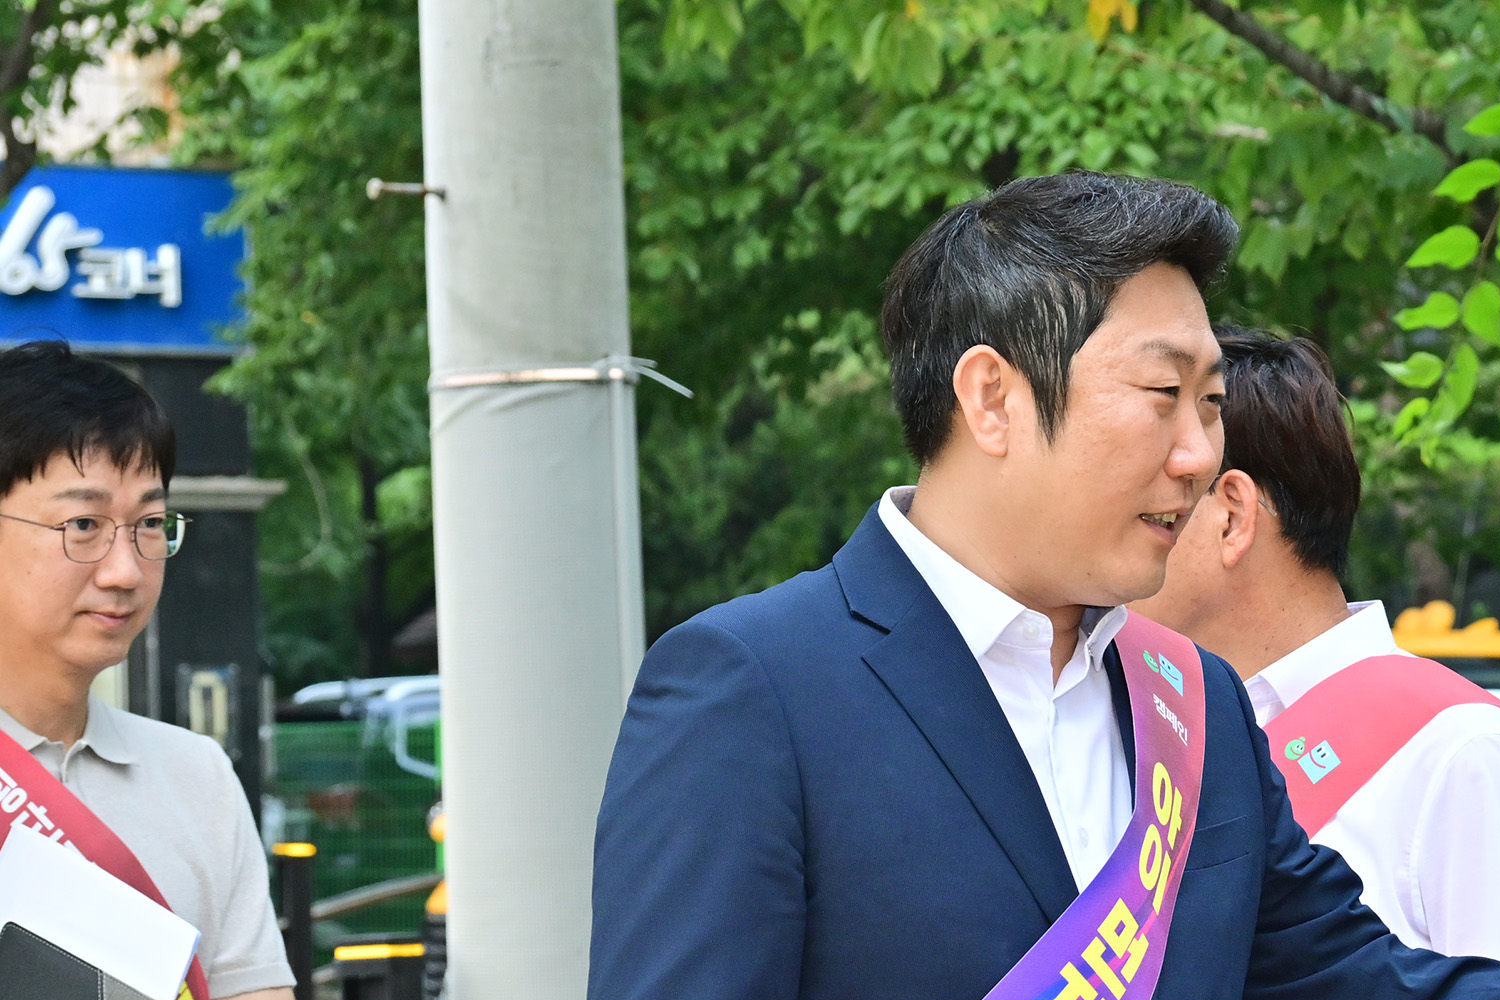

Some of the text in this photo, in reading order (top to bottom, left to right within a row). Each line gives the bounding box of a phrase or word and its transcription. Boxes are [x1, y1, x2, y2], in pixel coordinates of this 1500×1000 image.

[72, 242, 182, 308] 코너
[1152, 693, 1190, 746] 캠페인
[1138, 761, 1184, 916] 아이
